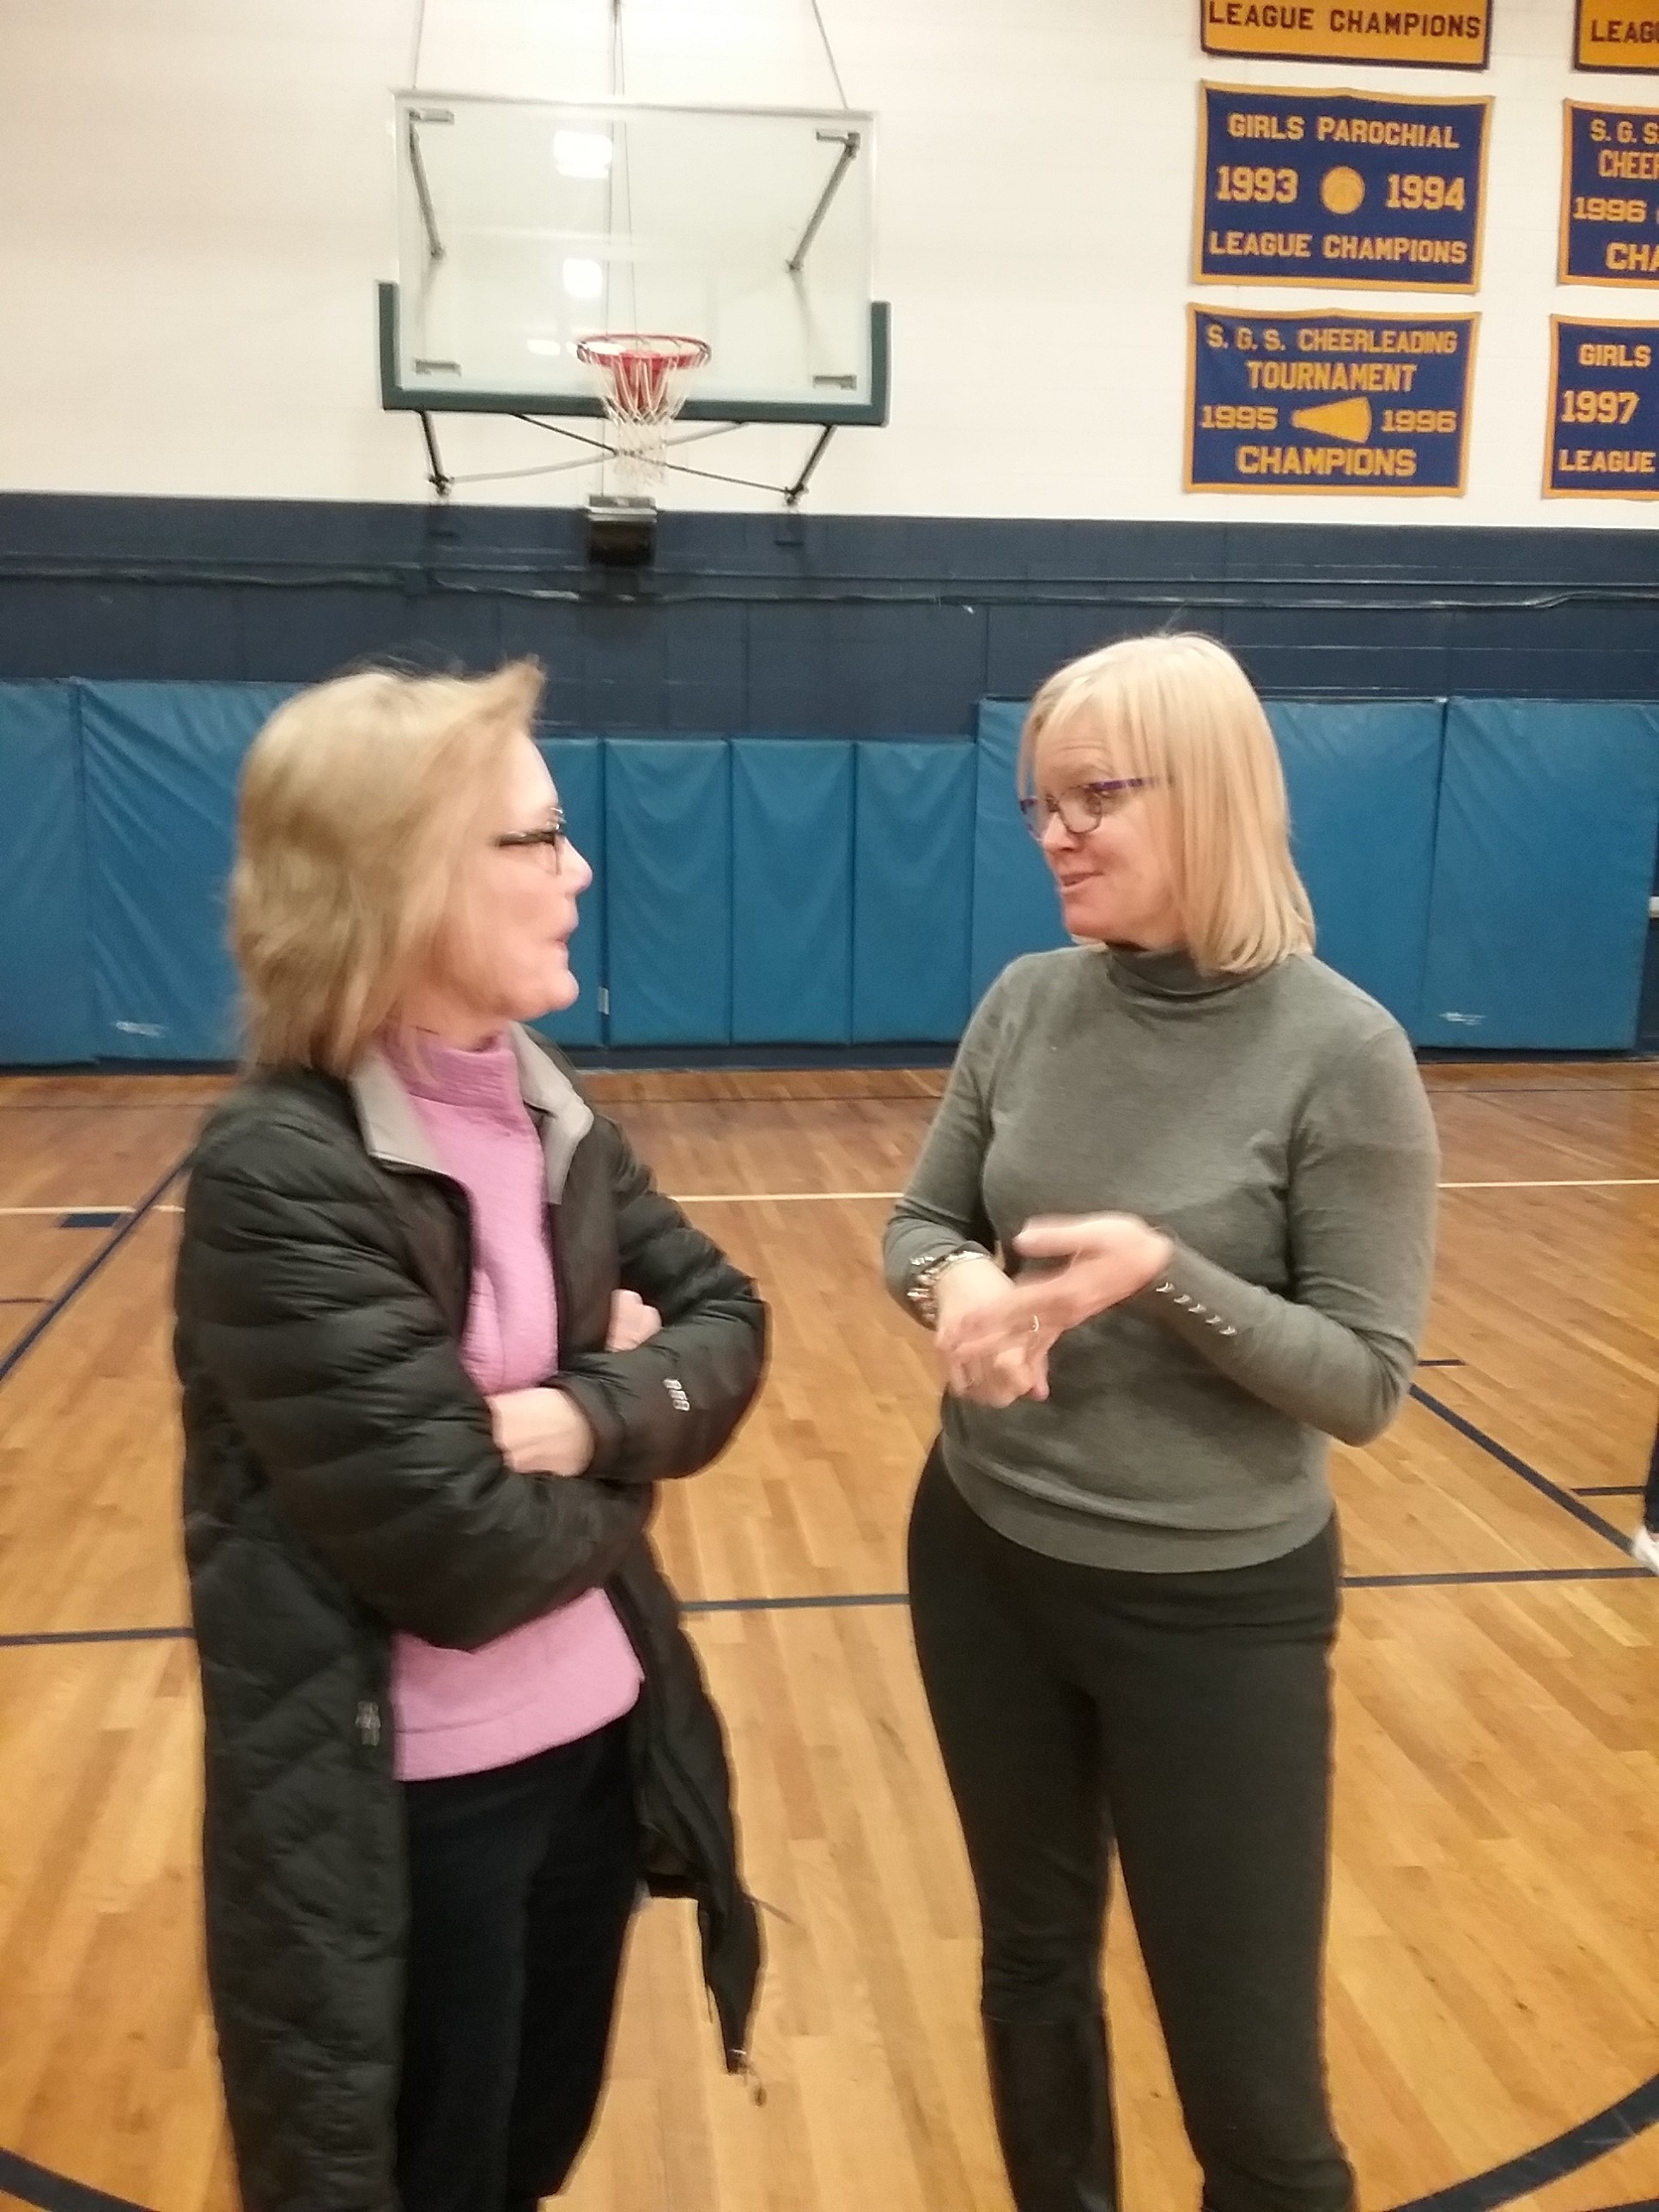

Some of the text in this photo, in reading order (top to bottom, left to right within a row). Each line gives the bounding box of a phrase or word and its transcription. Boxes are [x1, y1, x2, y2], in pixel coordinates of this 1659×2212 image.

[1208, 1, 1481, 40] LEAGUE CHAMPIONS
[1228, 112, 1460, 149] GIRLS PAROCHIAL
[1216, 166, 1466, 210] 1993 1994
[1573, 197, 1647, 222] 1996
[1208, 230, 1468, 264] LEAGUE CHAMPIONS
[1298, 327, 1458, 355] CHEERLEADING
[1578, 343, 1651, 368] GIRLS
[1246, 360, 1417, 392] TOURNAMENT
[1200, 404, 1457, 433] 1995 1996
[1561, 390, 1640, 424] 1997
[1237, 445, 1417, 476] CHAMPIONS
[1559, 448, 1656, 473] LEAGUE
